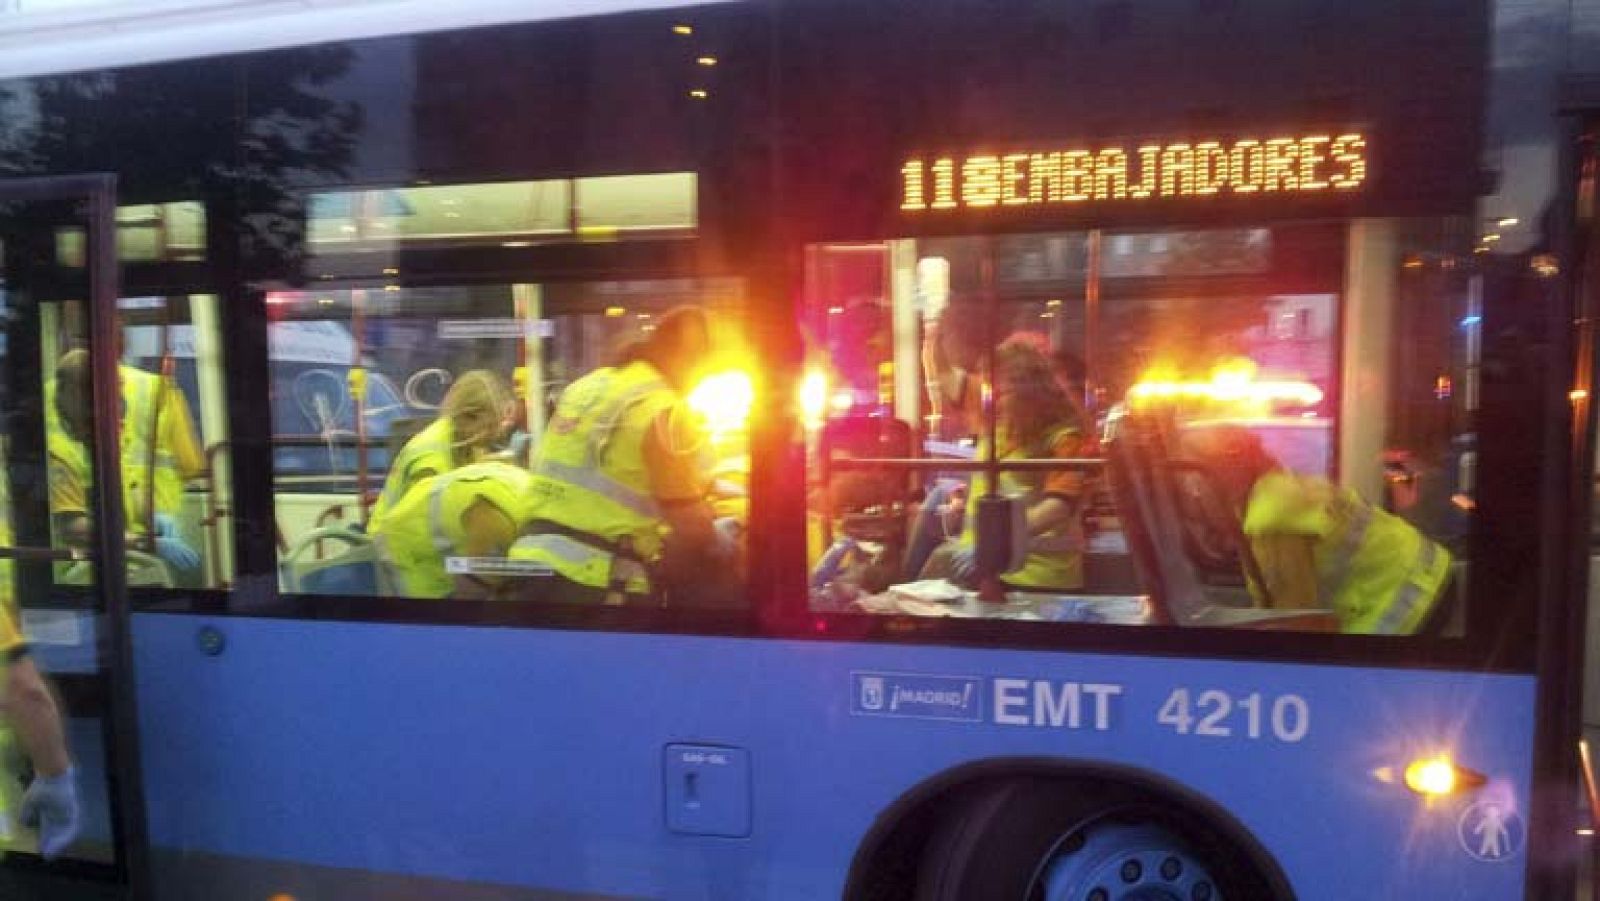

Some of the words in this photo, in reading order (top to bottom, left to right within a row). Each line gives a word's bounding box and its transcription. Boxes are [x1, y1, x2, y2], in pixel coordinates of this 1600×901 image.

[901, 156, 1000, 210] 118
[1001, 135, 1366, 205] EMBAJADORES
[993, 679, 1121, 730] EMT
[1157, 688, 1310, 742] 4210
